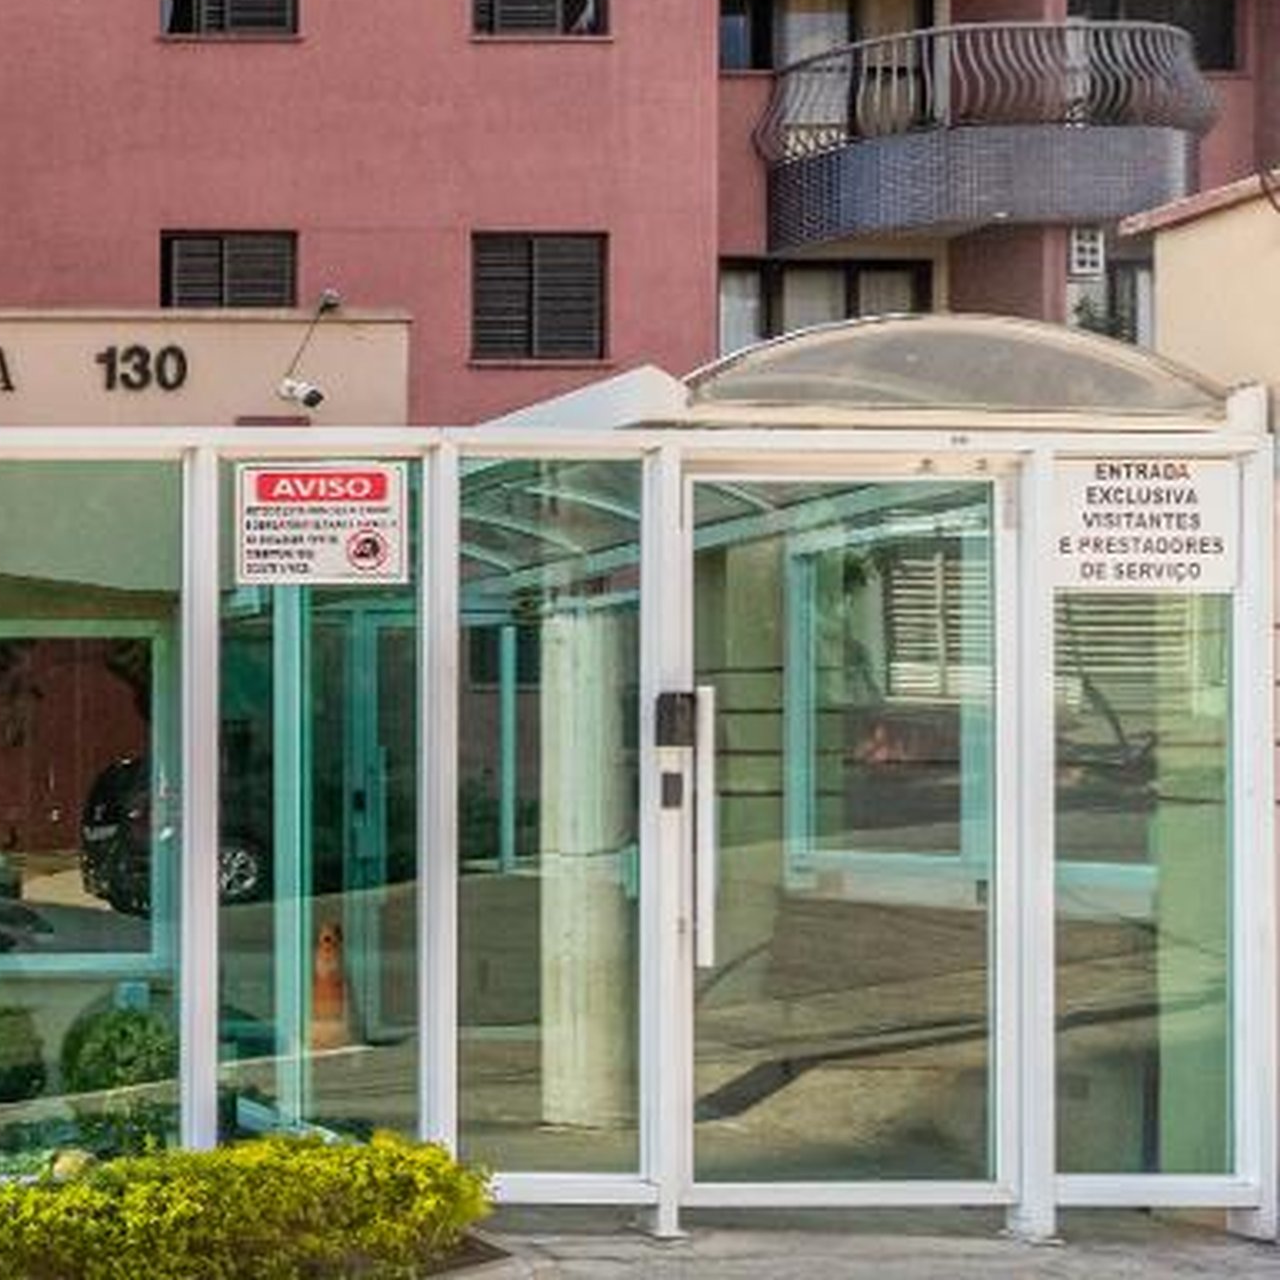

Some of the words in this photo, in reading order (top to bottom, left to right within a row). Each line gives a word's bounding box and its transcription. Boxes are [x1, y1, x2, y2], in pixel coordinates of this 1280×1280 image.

[95, 344, 188, 392] 130
[1095, 462, 1191, 480] ENTRADA
[271, 477, 372, 497] AVISO
[1086, 486, 1199, 505] EXCLUSIVA
[1082, 511, 1202, 530] VISITANTES
[1058, 537, 1073, 555] E
[1078, 536, 1225, 555] PRESTADORES
[1080, 562, 1108, 580] DE
[1114, 562, 1202, 583] SERVIÇO
